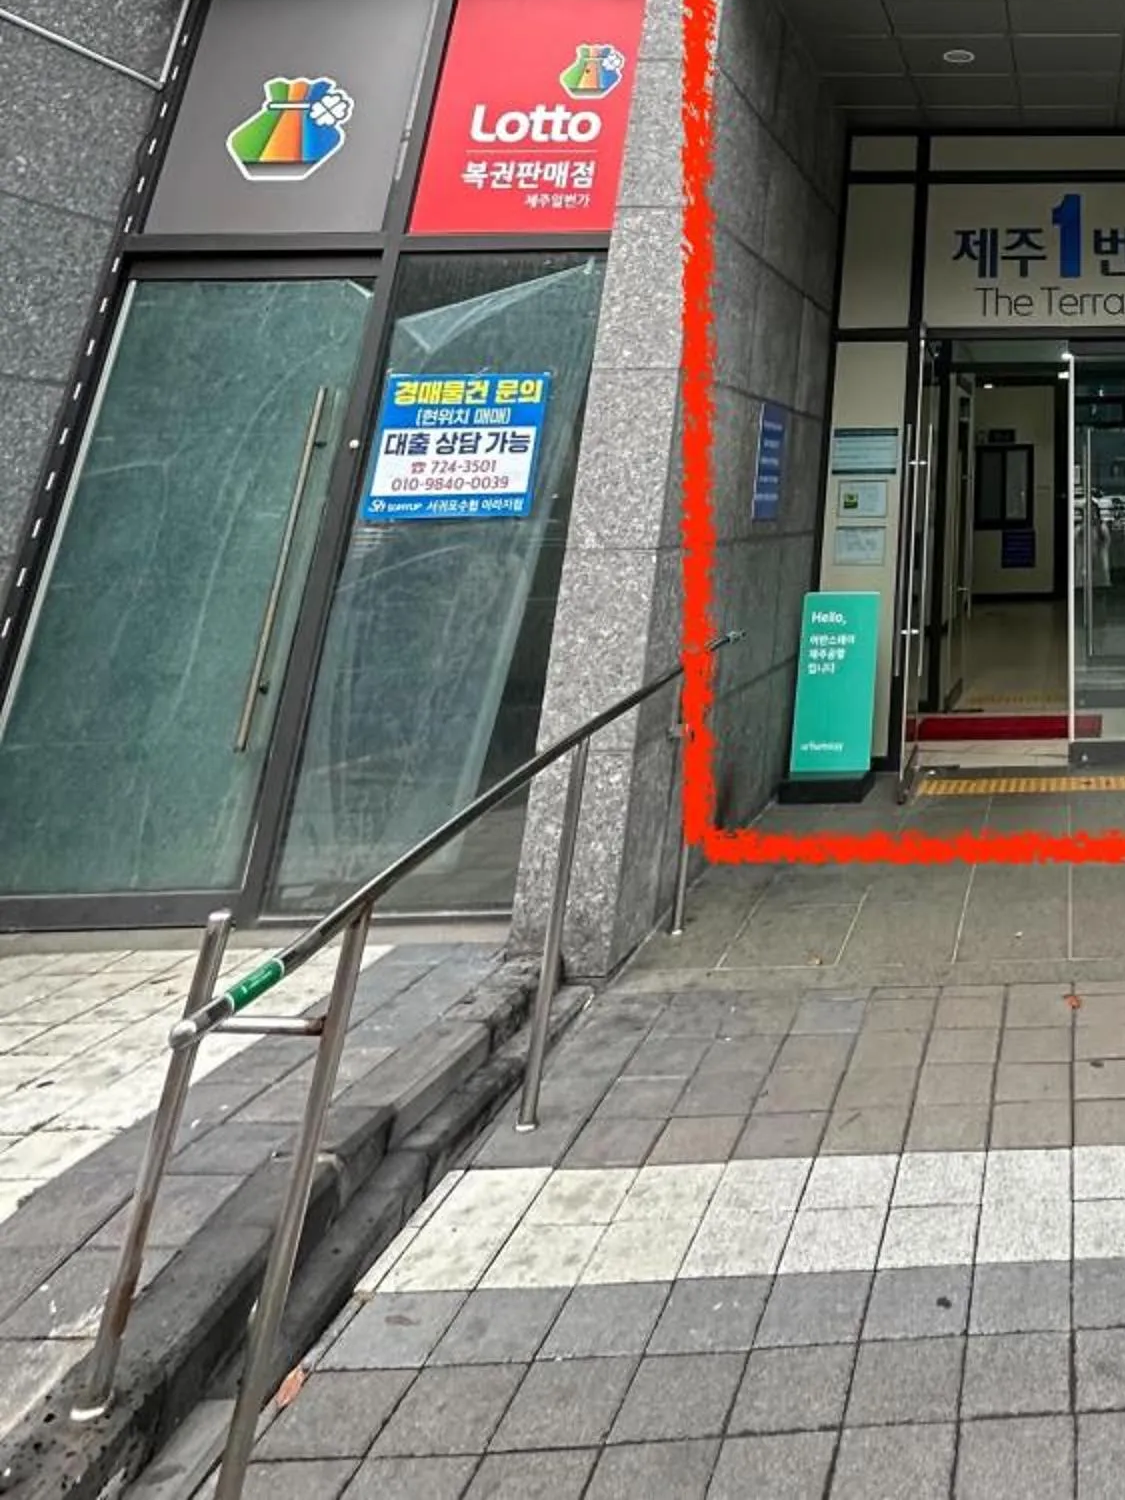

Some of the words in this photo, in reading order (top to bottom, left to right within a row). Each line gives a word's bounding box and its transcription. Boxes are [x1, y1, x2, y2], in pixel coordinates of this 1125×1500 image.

[470, 104, 602, 142] Lotto
[461, 161, 596, 190] 복권판매점
[974, 286, 1034, 317] The
[393, 380, 489, 405] 경매물건
[495, 379, 543, 404] 문의
[384, 432, 430, 456] 대출
[435, 433, 482, 455] 상담
[485, 431, 531, 455] 가능
[431, 459, 497, 475] 724-3501
[391, 476, 509, 491] 010-9840-0039
[811, 611, 847, 626] Hello,
